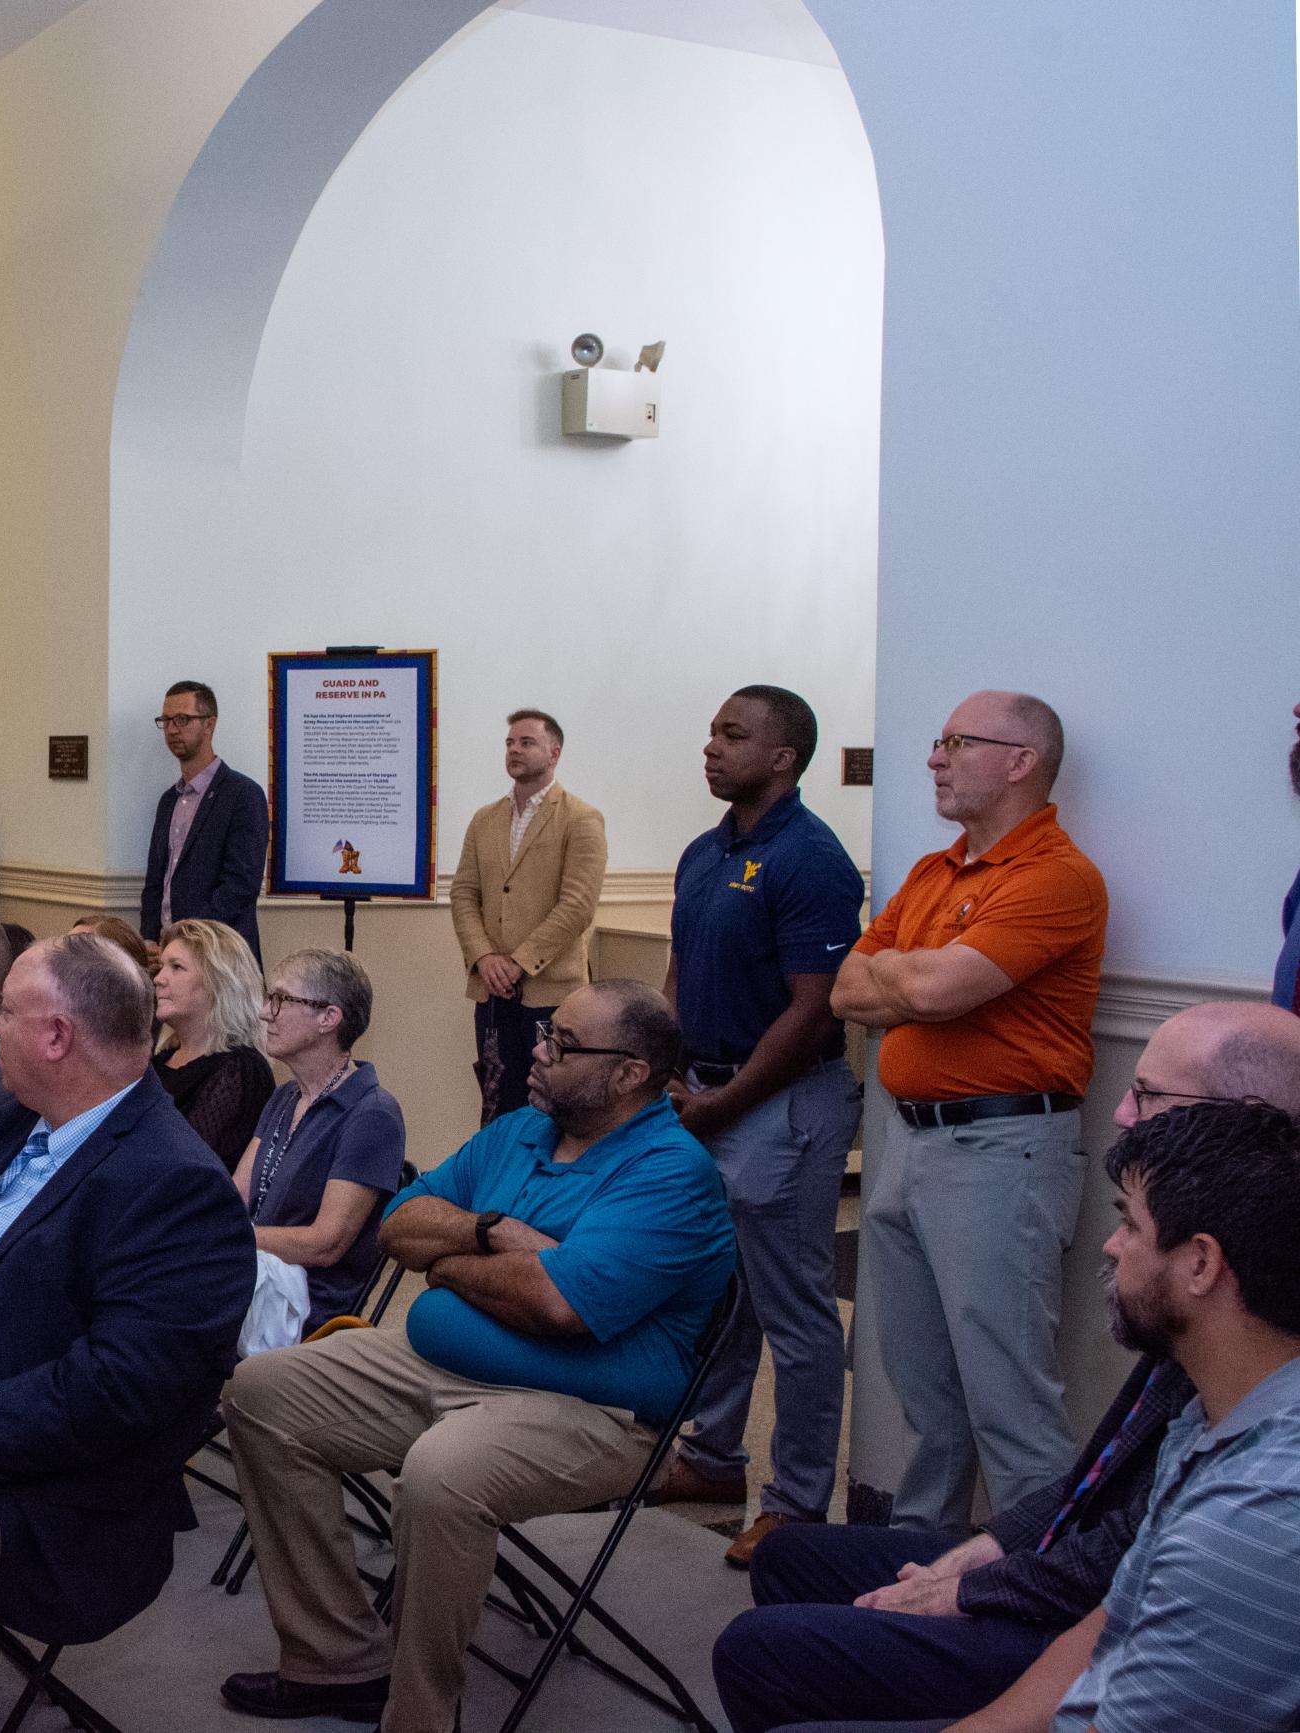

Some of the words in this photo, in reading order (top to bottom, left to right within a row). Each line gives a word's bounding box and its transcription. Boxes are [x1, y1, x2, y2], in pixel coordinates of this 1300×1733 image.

[322, 679, 356, 688] GUARD
[358, 679, 380, 687] AND
[315, 691, 360, 699] RESERVE
[373, 690, 386, 698] PA
